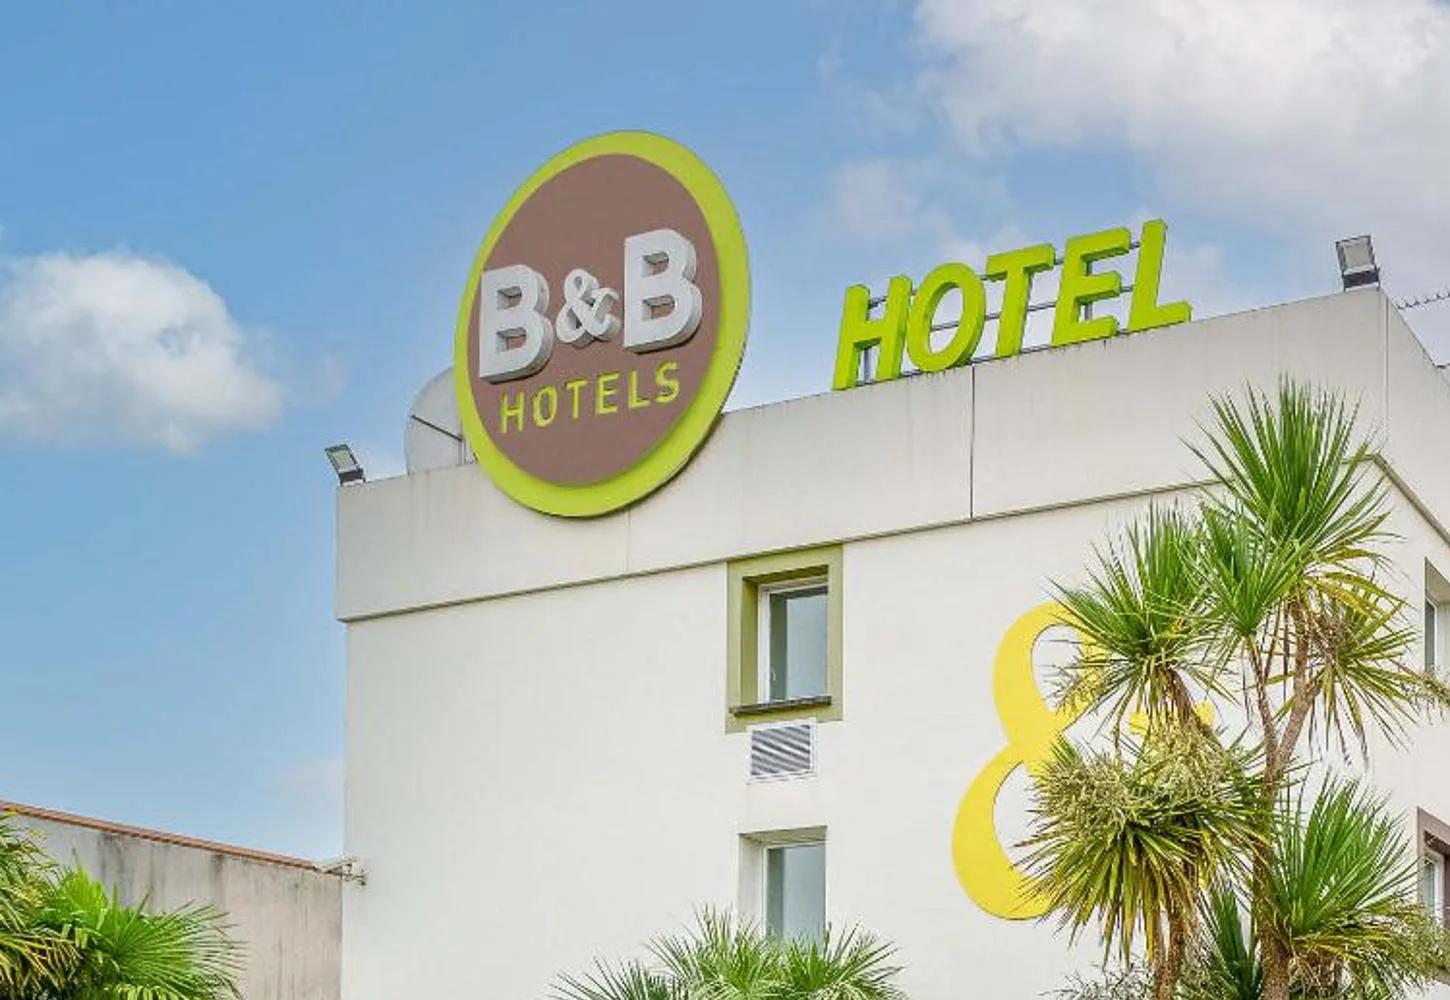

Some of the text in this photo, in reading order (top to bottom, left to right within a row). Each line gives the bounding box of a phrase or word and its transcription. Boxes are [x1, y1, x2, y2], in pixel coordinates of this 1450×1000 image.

[478, 229, 702, 381] B&B
[833, 219, 1192, 391] HOTEL
[500, 361, 680, 434] HOTELS
